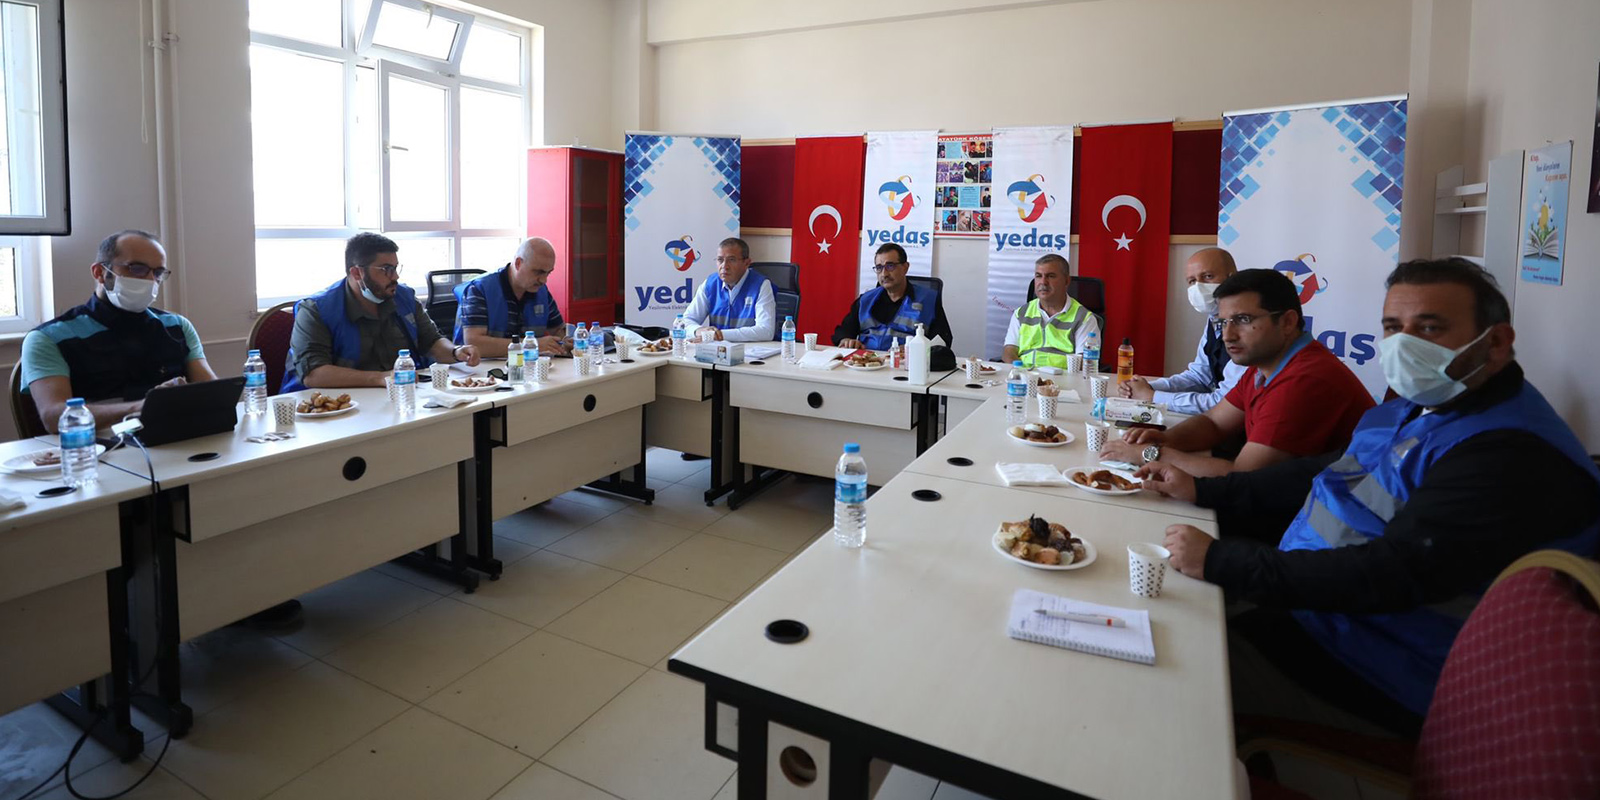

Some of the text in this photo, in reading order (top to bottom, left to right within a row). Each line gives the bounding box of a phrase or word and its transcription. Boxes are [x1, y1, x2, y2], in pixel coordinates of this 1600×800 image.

[866, 225, 930, 246] yedaş
[994, 228, 1066, 251] yedaş
[635, 278, 693, 311] yed
